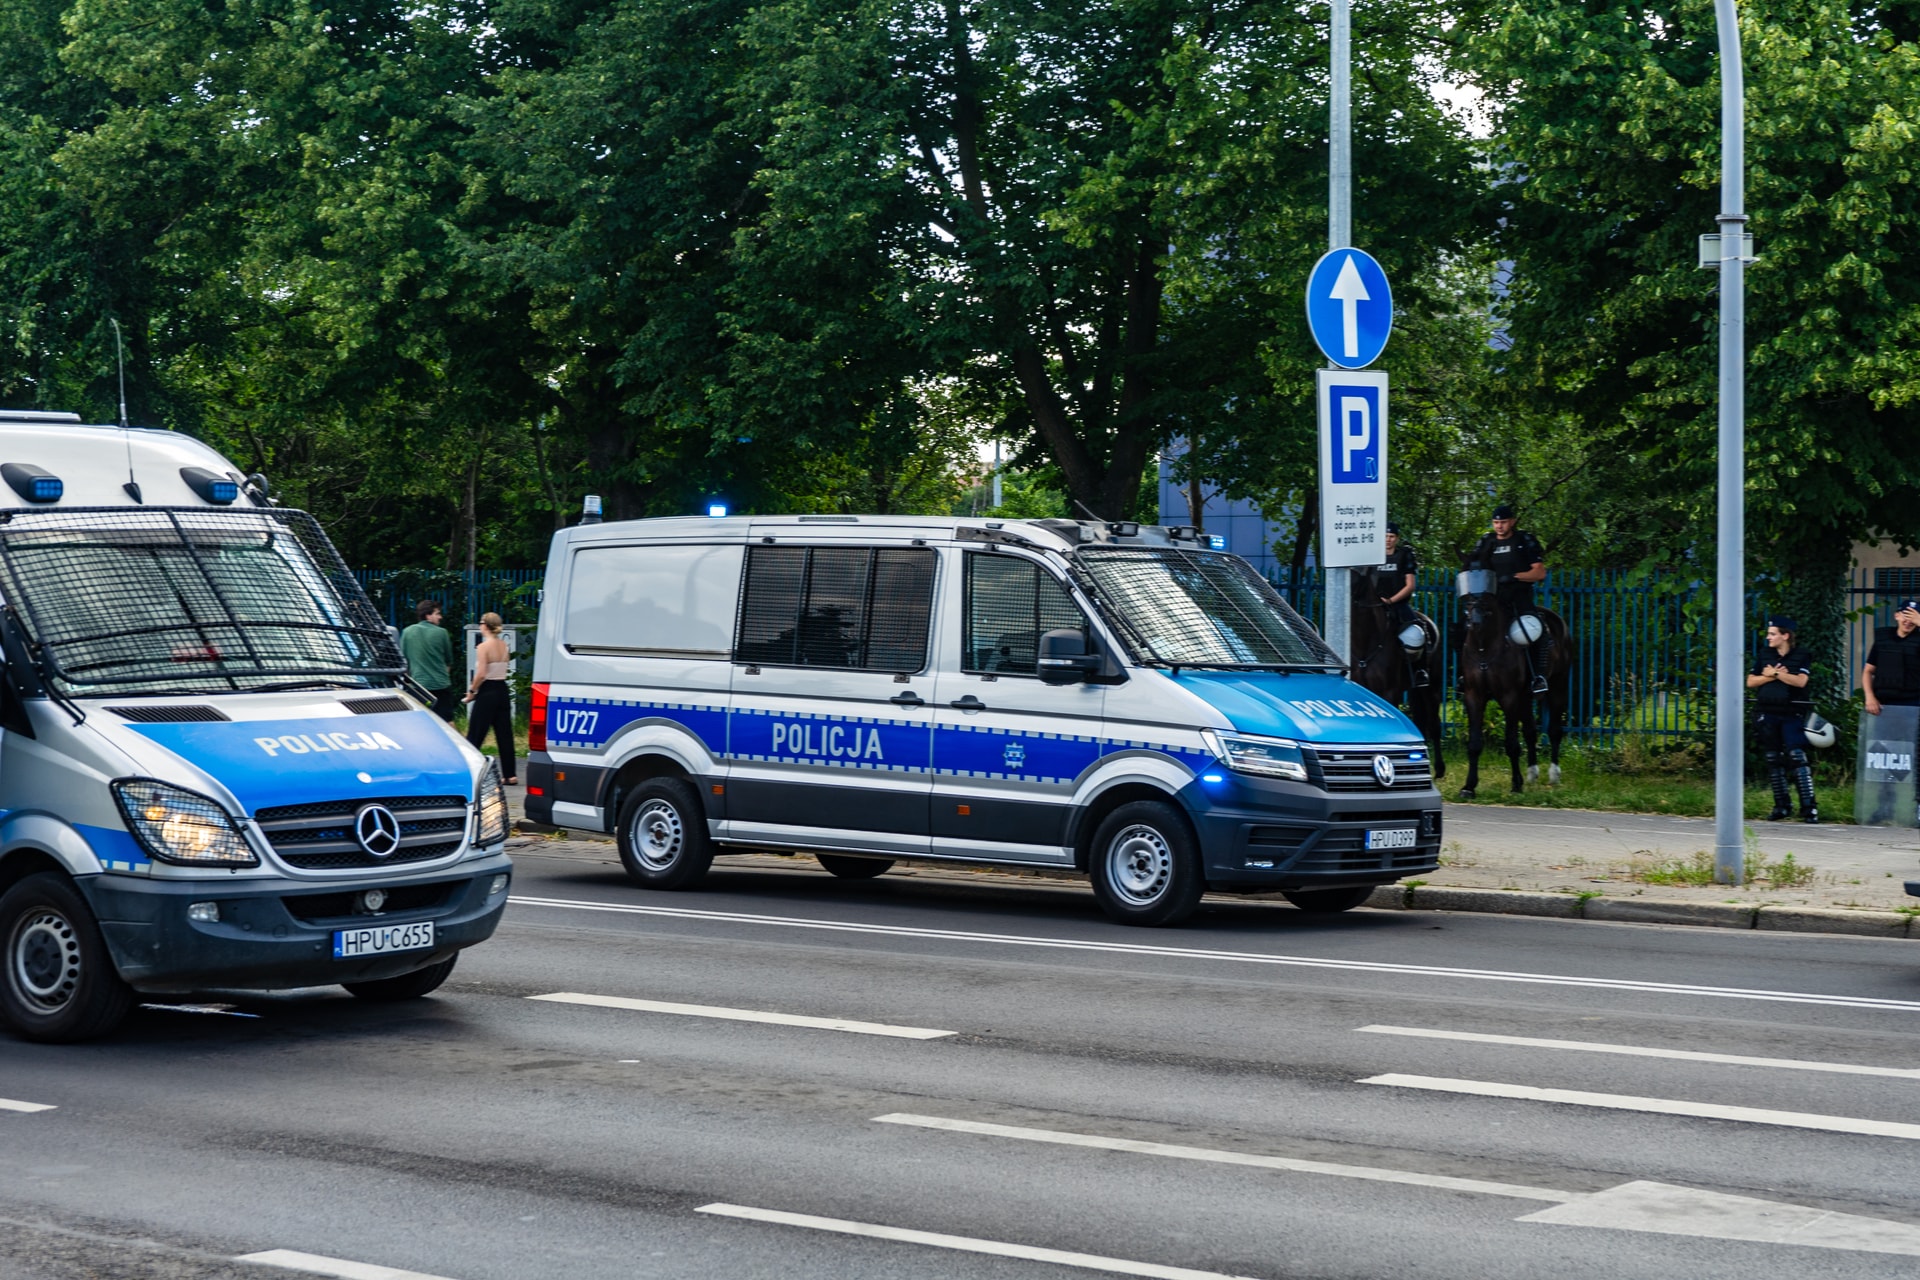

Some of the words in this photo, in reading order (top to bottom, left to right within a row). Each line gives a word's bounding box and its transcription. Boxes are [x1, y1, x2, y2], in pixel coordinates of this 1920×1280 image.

[1341, 396, 1370, 472] P
[556, 709, 599, 735] U727
[1289, 699, 1396, 719] POLICJA
[253, 731, 403, 757] POLICJA
[772, 722, 884, 760] POLICJA
[1866, 752, 1911, 770] POLICJA
[1371, 831, 1390, 848] HPU
[345, 930, 385, 954] HPU
[391, 924, 431, 949] C655
